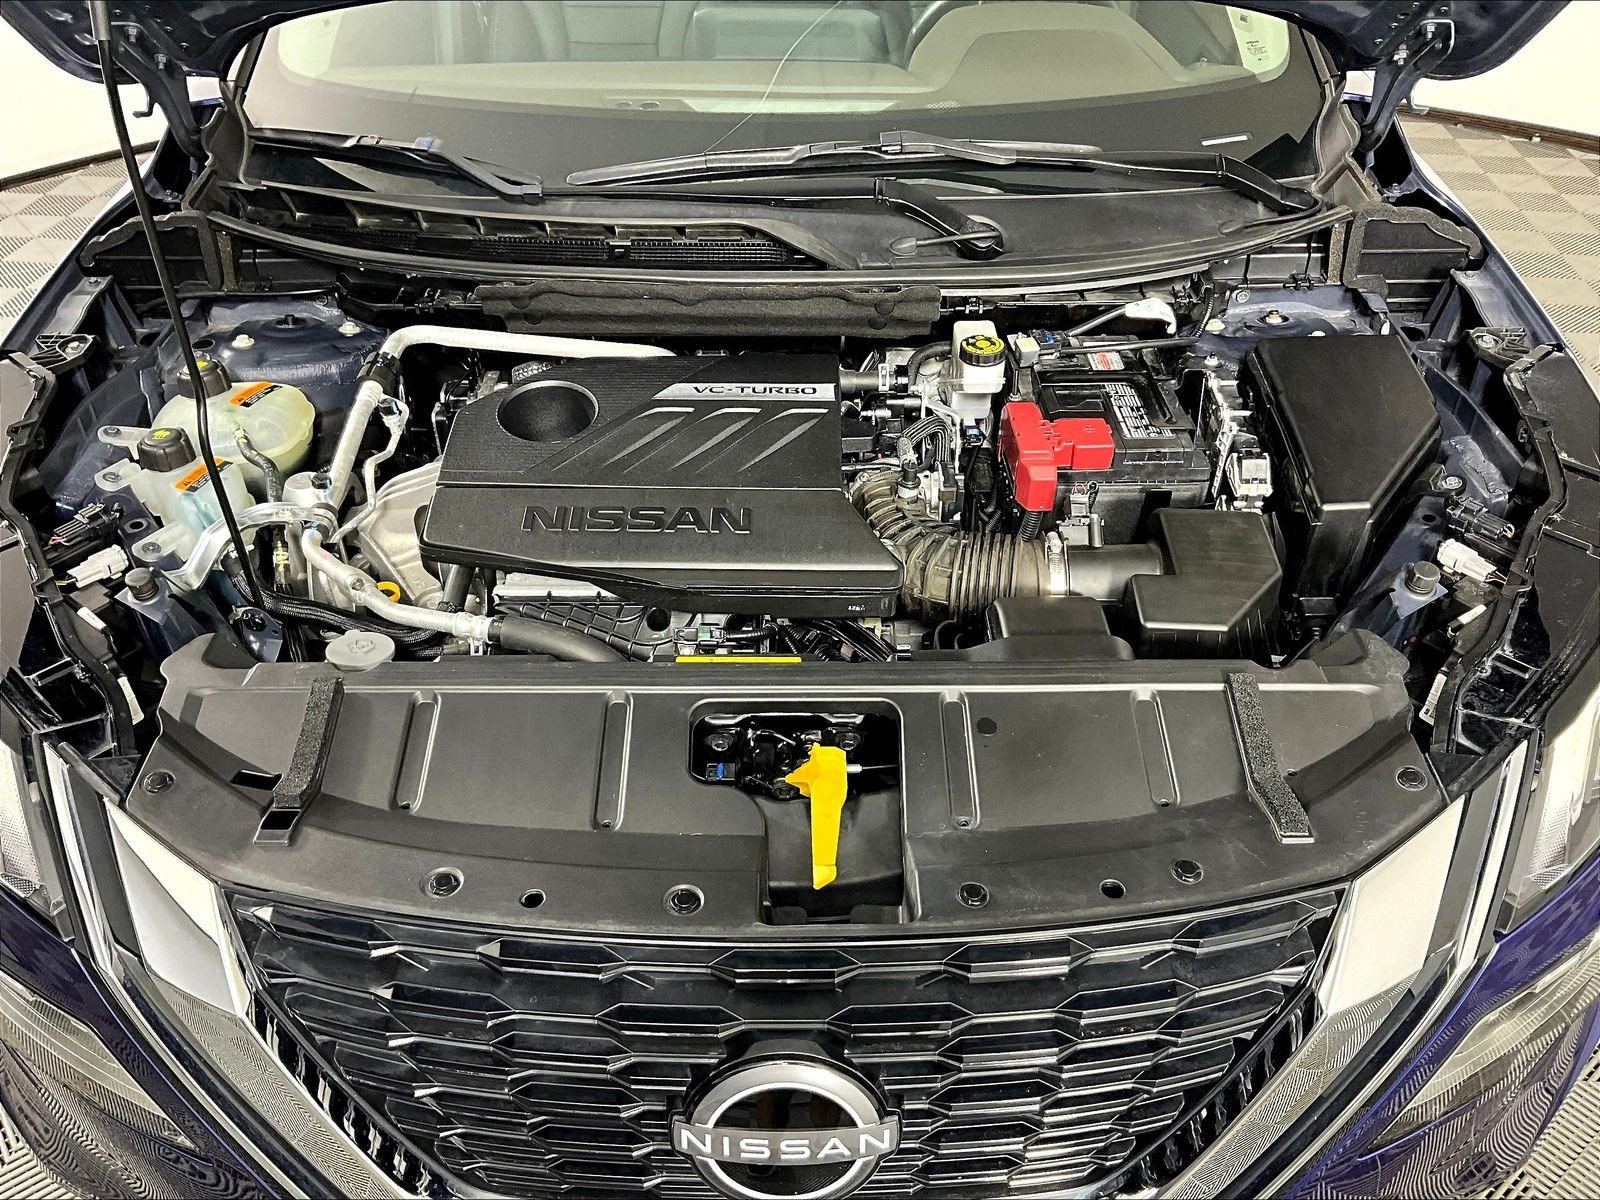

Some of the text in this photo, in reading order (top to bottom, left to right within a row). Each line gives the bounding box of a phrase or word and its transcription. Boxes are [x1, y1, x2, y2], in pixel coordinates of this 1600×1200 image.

[692, 386, 817, 395] VC-TURBO
[521, 506, 753, 534] NISSAN
[680, 1128, 890, 1159] NISSAN
